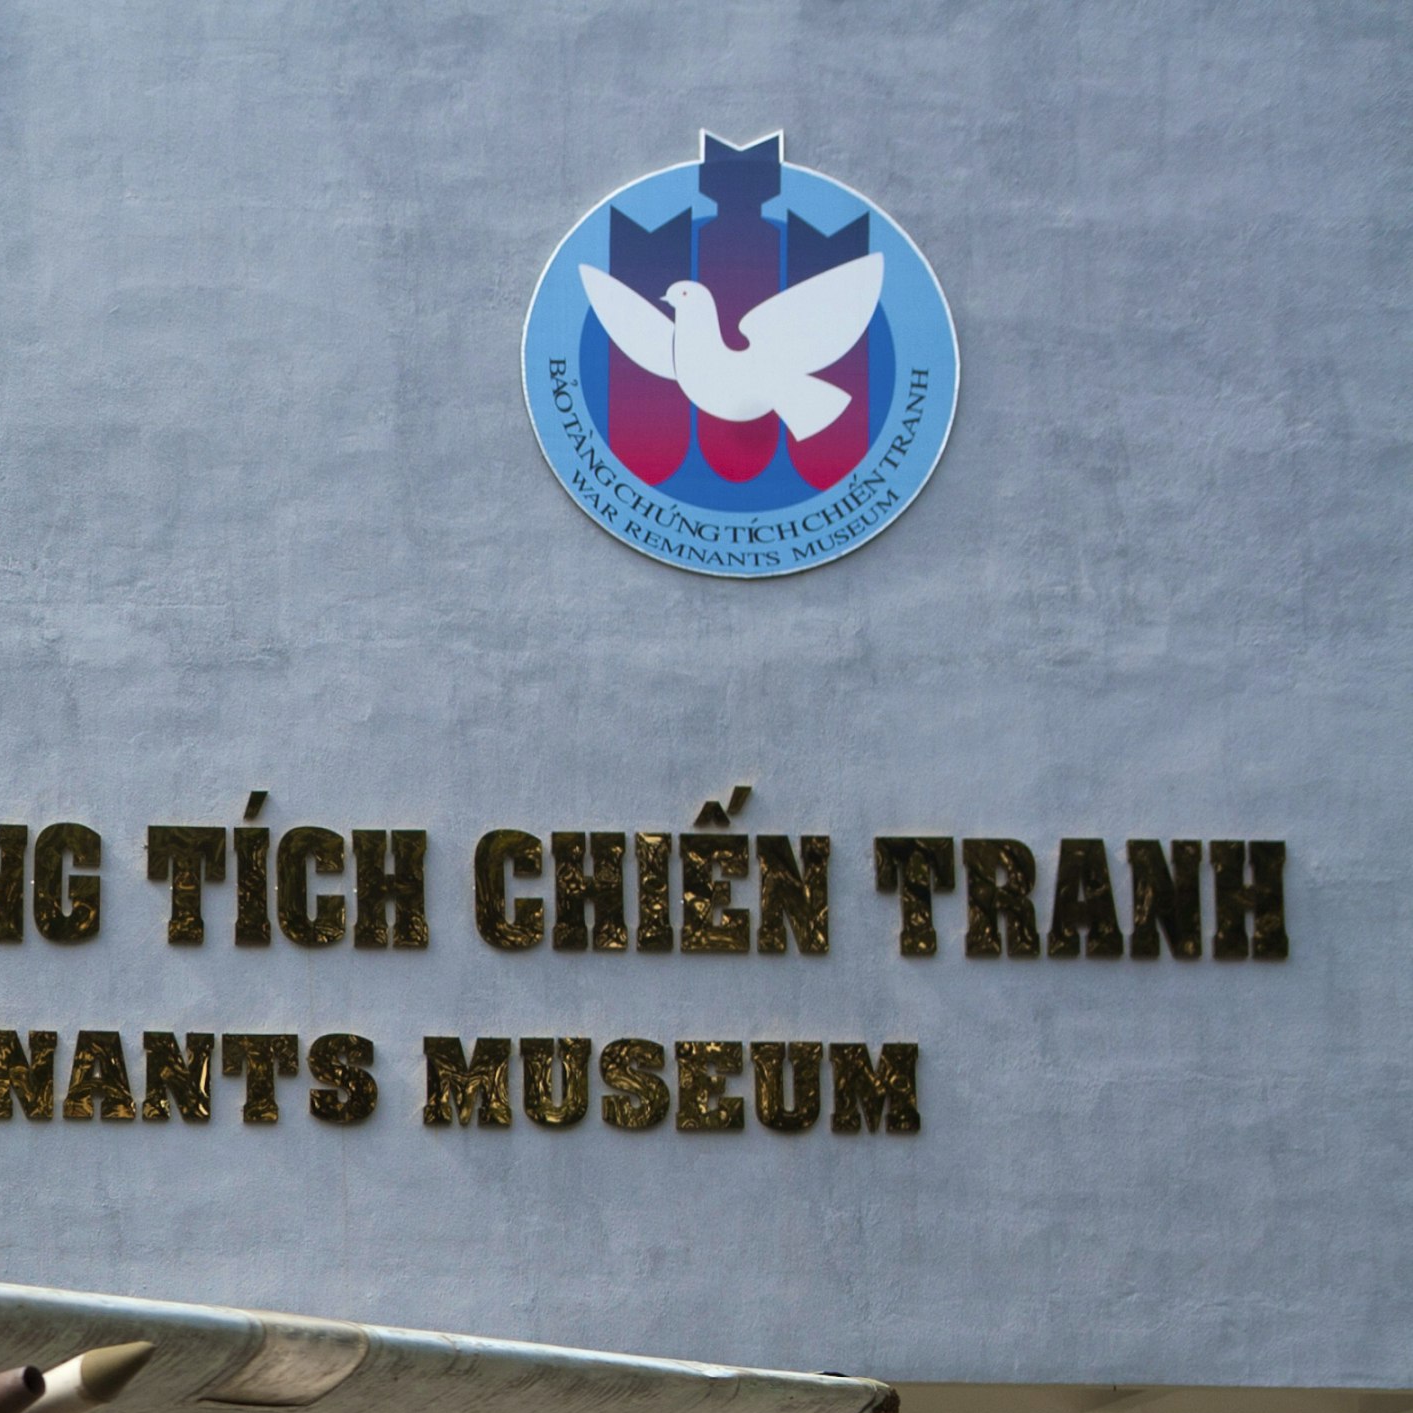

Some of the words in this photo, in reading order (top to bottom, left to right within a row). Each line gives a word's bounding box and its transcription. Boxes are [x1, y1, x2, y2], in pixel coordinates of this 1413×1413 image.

[548, 357, 578, 413] BẢO
[563, 412, 616, 488] TÀNG
[614, 482, 720, 542] CHỨNG
[724, 517, 798, 545] TÍCH
[801, 473, 886, 533] CHIẾN
[879, 367, 929, 471] TRANH
[570, 468, 619, 524] WAR
[623, 519, 781, 567] REMNANTS
[791, 488, 900, 562] MUSEUM
[146, 790, 429, 948] TÍCH
[473, 786, 830, 953] CHIẾN
[874, 836, 1289, 960] TRANH
[423, 1036, 922, 1134] MUSEUM
